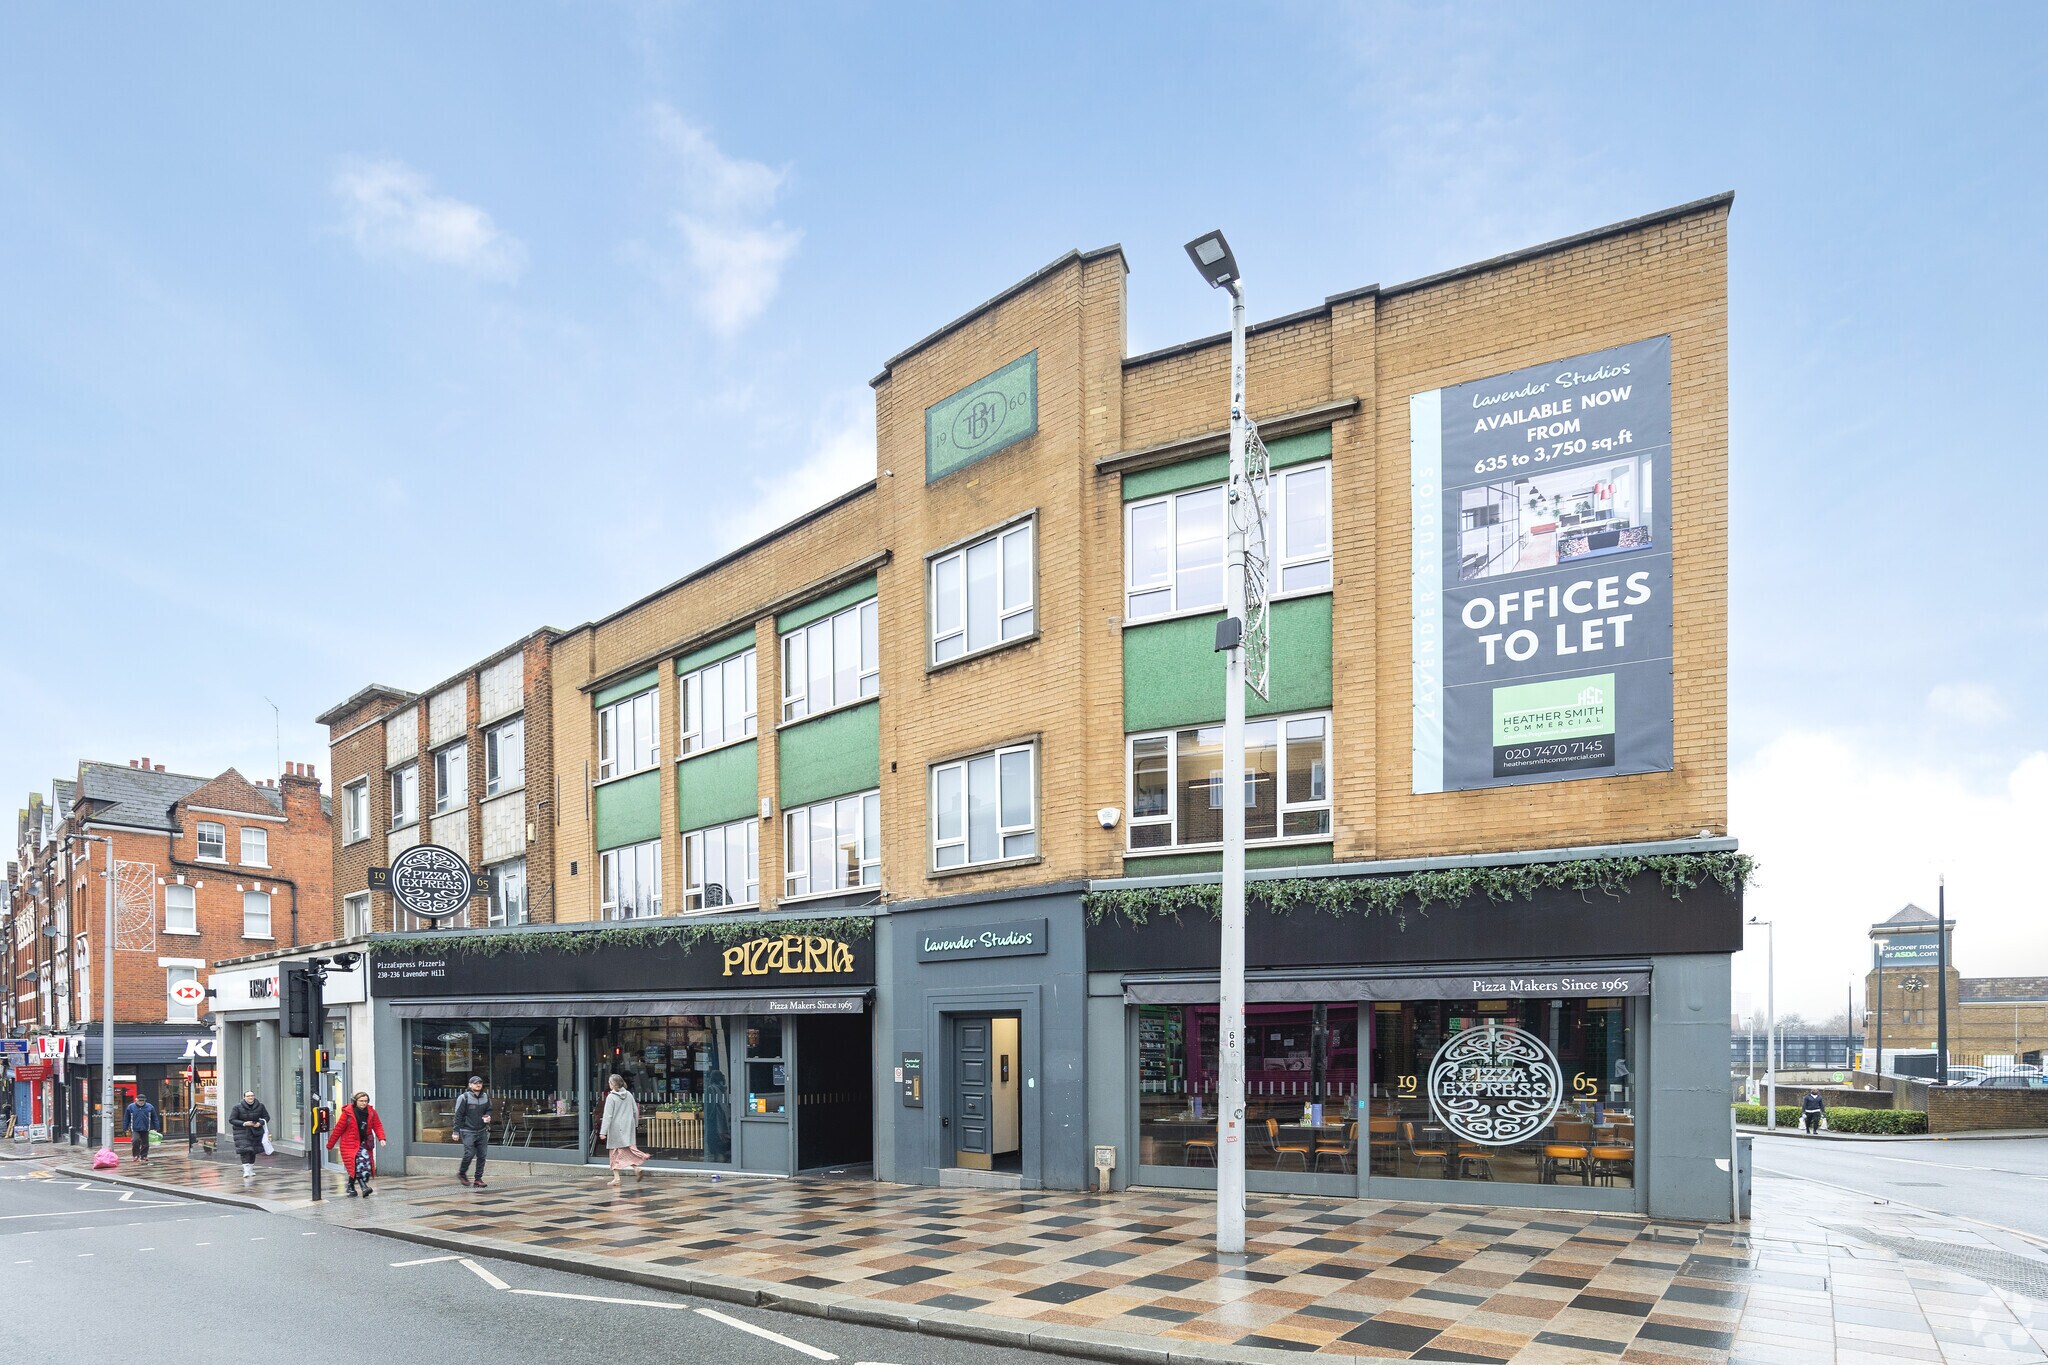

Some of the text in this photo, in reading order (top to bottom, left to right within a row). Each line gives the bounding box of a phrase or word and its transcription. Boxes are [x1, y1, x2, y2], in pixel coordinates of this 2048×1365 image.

[1472, 363, 1631, 409] Lavender Studios
[1009, 391, 1027, 410] 60
[1473, 385, 1632, 433] AVAILABLE NOW
[1527, 418, 1581, 442] FROM
[1474, 429, 1633, 474] 635 to 3,750 sq.ft
[1420, 467, 1435, 720] LAVENDER STUDIOS
[1461, 571, 1652, 630] OFFICES
[1478, 613, 1633, 666] TO LET
[1577, 686, 1603, 705] HSC
[1503, 706, 1604, 726] HEATHER SMITH
[1503, 717, 1601, 733] COMMERCIAL
[1503, 752, 1606, 768] heathersmithcommercial.com
[1505, 740, 1603, 760] 020 7470 7145
[374, 871, 489, 890] 19 EXPRESS 65
[412, 870, 452, 881] PIZZA
[924, 931, 1033, 952] Lavender Studios
[722, 934, 854, 976] PIZZERIA
[1894, 950, 1938, 958] ASDA.com
[377, 960, 446, 970] PizzaExpress Pizzeria
[402, 970, 429, 978] Lavender
[431, 969, 445, 977] Hill
[249, 977, 272, 999] HSBC
[1472, 977, 1629, 992] Pizza Makers Since 1965
[769, 1000, 853, 1011] Pizza Makers Since 1965
[1397, 1071, 1598, 1098] 19 EXPRESS 65
[1460, 1067, 1528, 1082] PIZZA
